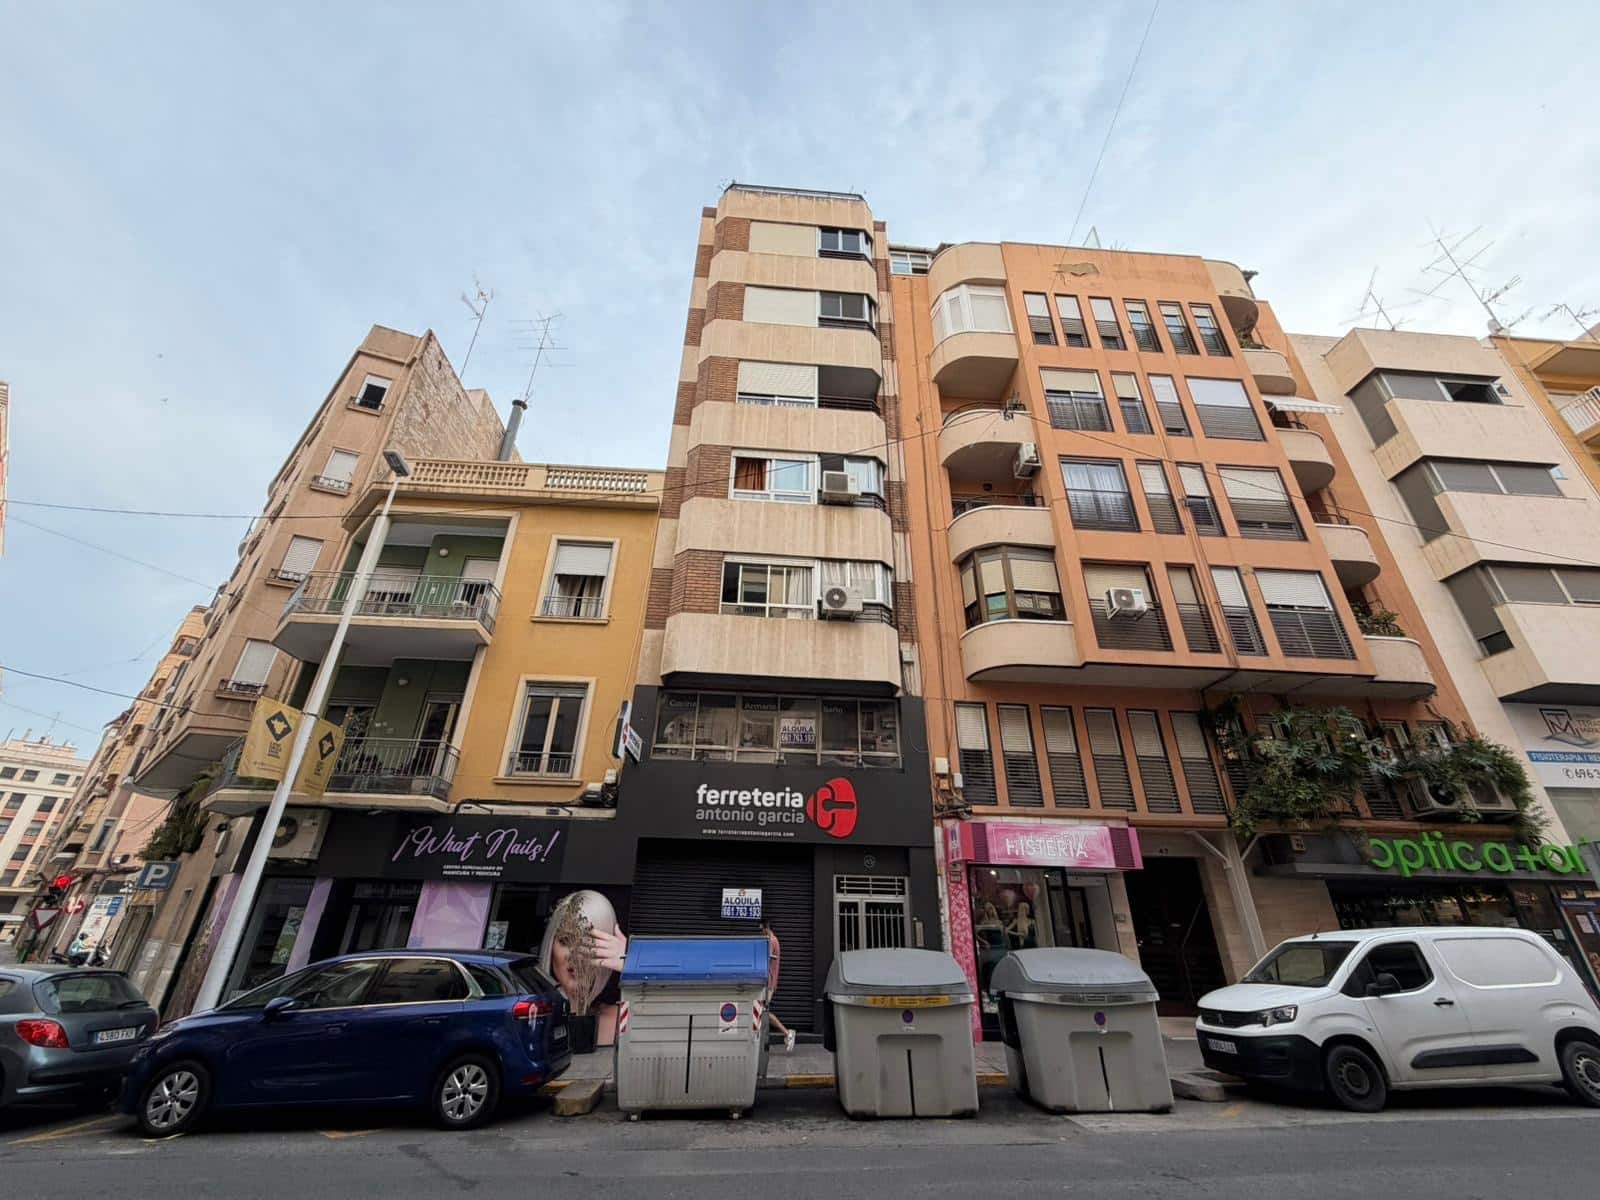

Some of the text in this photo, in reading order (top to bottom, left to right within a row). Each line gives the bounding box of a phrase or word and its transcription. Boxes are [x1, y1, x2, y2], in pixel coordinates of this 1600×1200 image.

[696, 783, 804, 808] ferreteria
[695, 808, 754, 821] antonio
[1006, 838, 1089, 858] HISTERIA
[143, 864, 170, 888] P
[724, 897, 761, 905] ALQUILA
